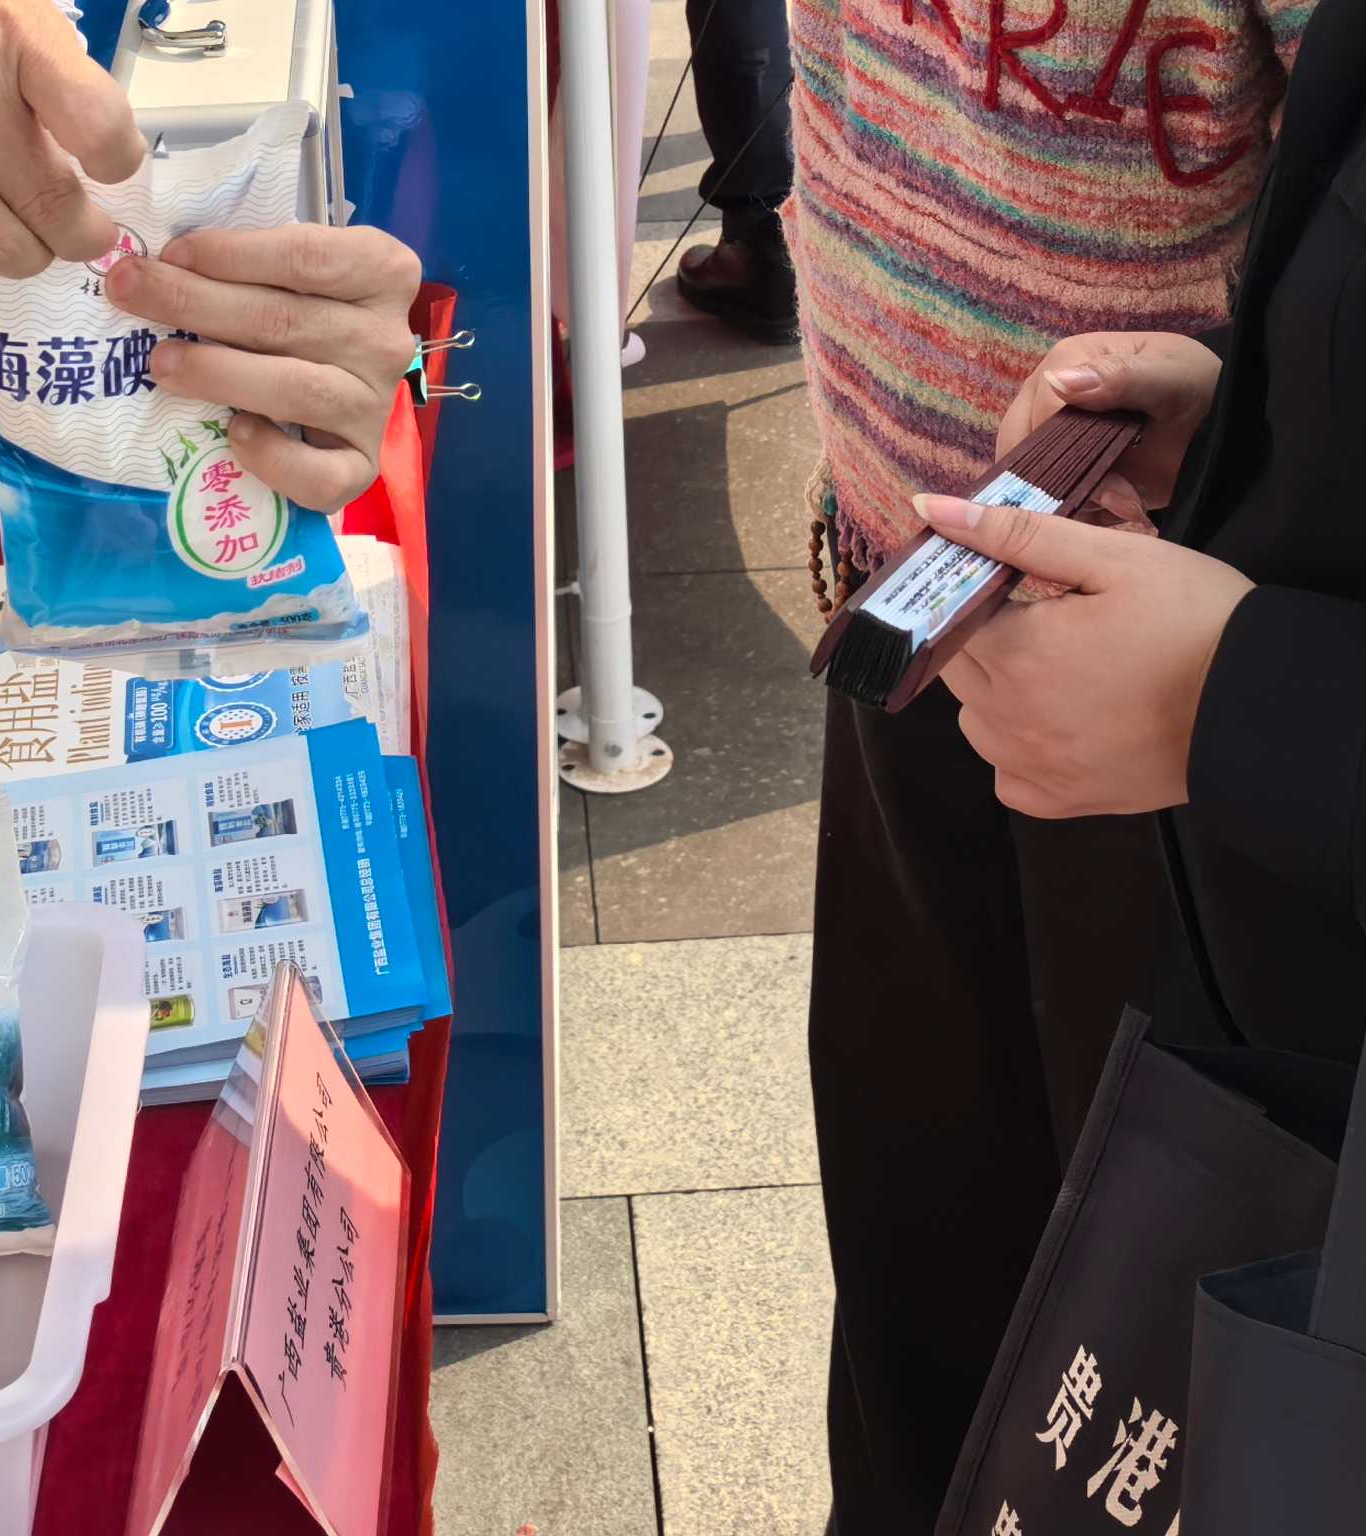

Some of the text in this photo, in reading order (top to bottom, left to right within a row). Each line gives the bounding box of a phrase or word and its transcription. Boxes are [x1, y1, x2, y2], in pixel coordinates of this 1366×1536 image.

[199, 458, 261, 564] 零添加
[65, 716, 112, 764] Plant
[323, 1206, 362, 1392] 贵港分公司
[1034, 1343, 1181, 1529] 贵港
